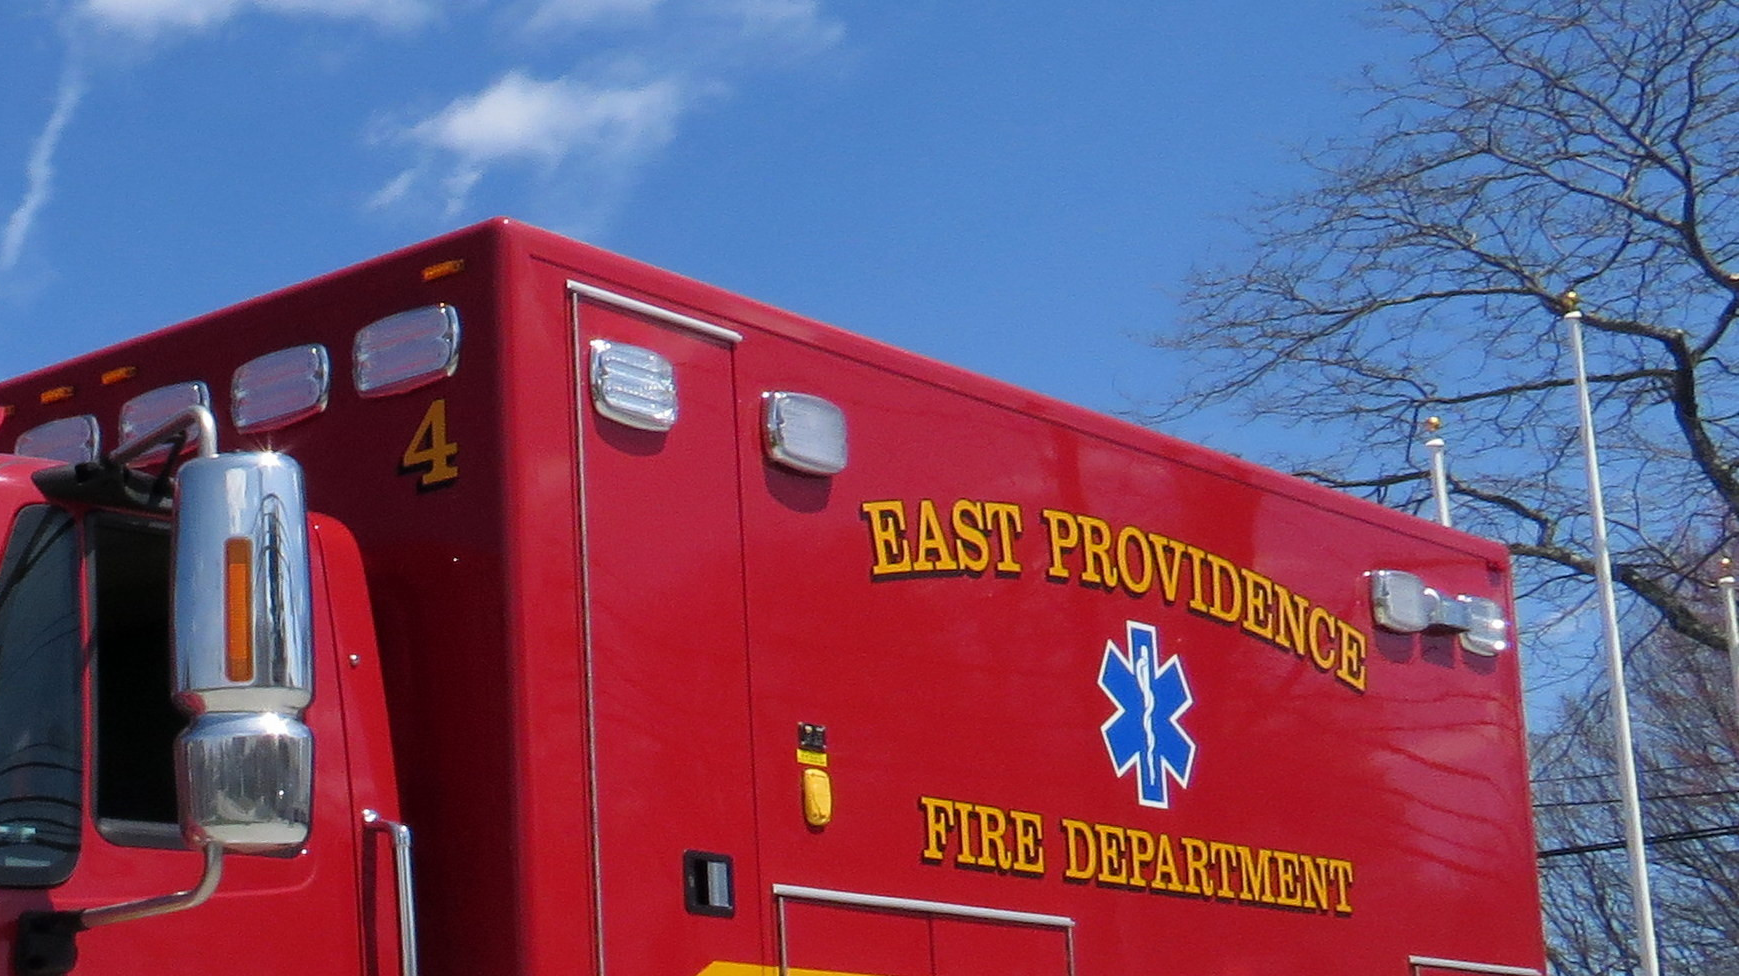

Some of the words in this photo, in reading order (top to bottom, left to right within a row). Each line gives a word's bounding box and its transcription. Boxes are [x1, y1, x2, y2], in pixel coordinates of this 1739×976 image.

[403, 399, 458, 485] 4
[862, 499, 1023, 577] EAST
[1042, 508, 1367, 692] PROVIDENCE
[920, 796, 1045, 875] FIRE
[1062, 817, 1353, 913] DEPARTMENT
